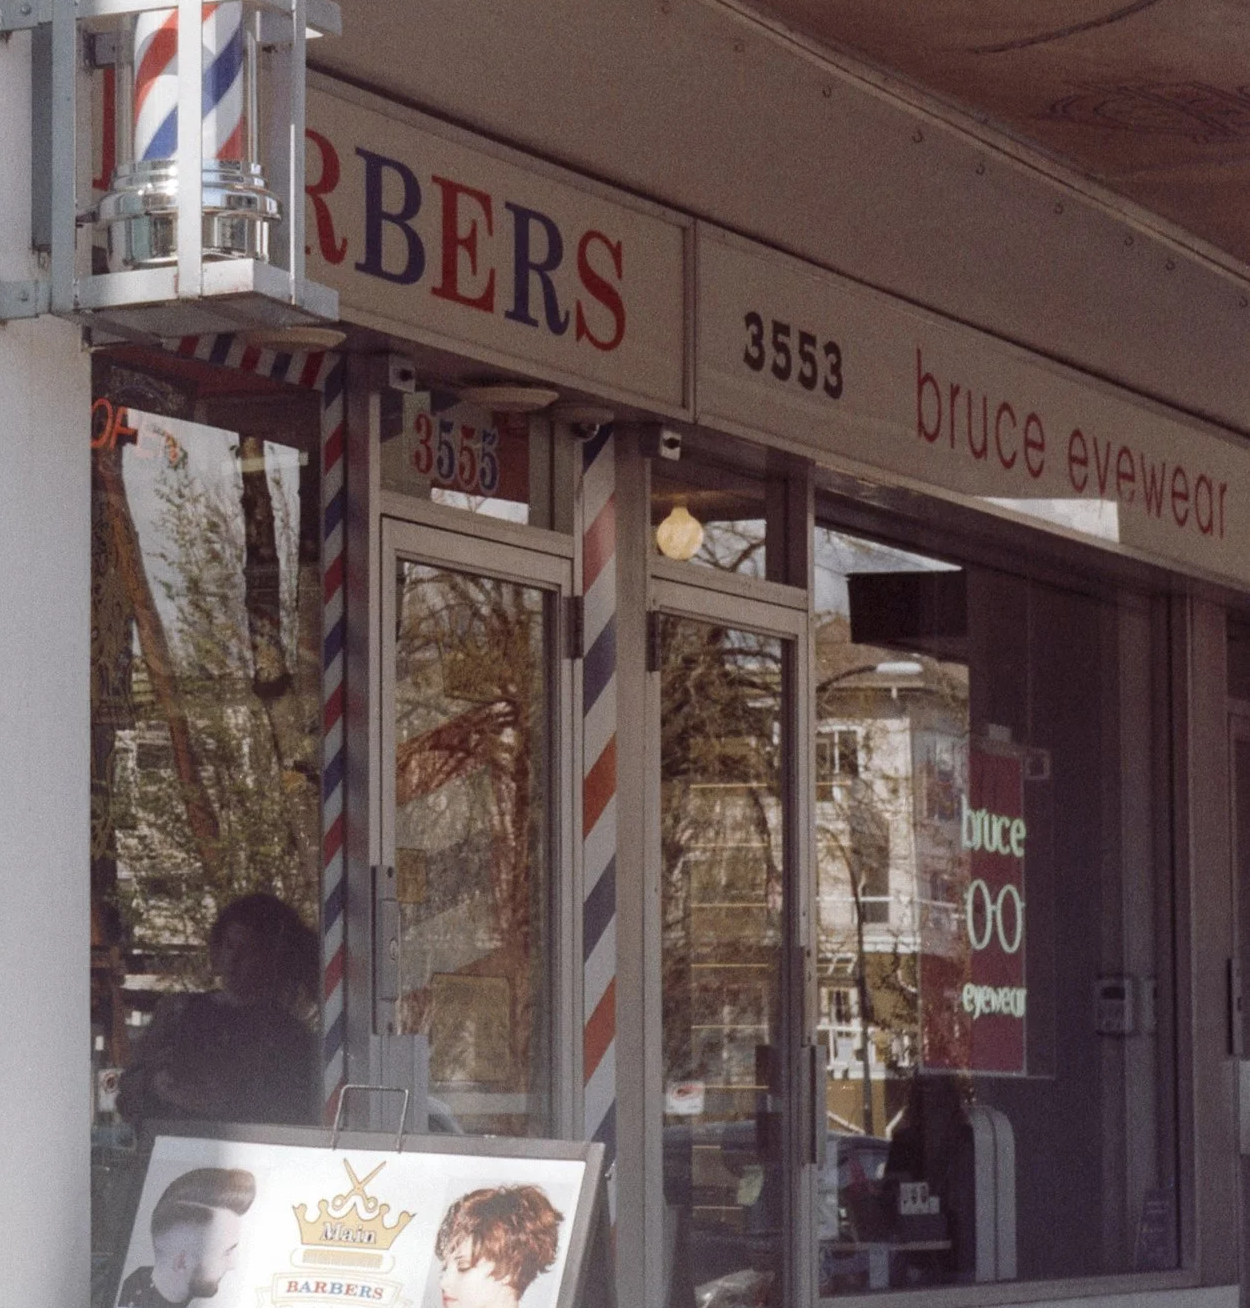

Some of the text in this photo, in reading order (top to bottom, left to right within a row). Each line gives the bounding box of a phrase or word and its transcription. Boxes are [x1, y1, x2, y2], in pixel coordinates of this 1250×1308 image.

[413, 412, 499, 491] 3555
[743, 311, 1228, 541] 3553 bruce eyewear
[961, 794, 1027, 858] bruce
[961, 981, 1028, 1020] eyewear
[320, 1221, 377, 1245] Main
[286, 1280, 384, 1300] BARBERS
